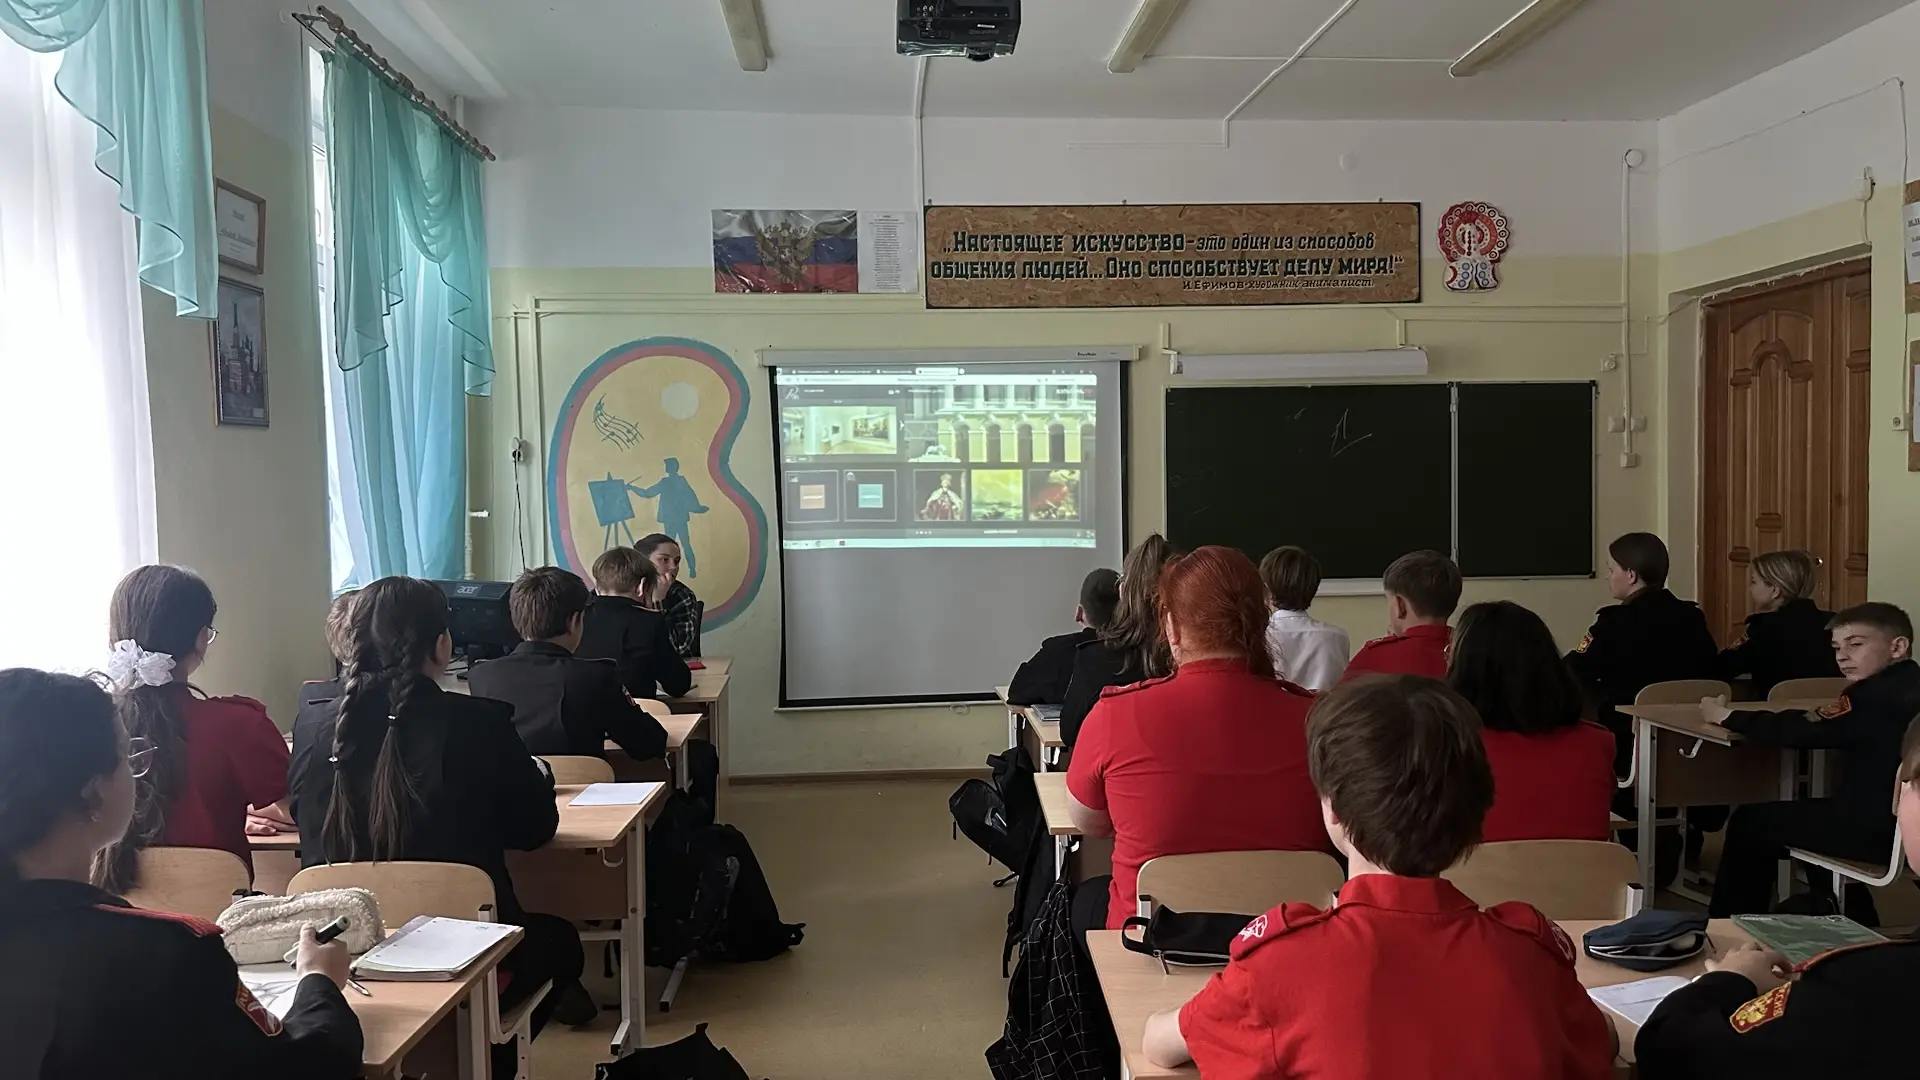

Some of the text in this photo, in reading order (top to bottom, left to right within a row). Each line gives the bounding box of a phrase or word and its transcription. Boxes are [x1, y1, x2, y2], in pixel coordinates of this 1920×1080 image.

[1232, 232, 1271, 251] один
[1274, 235, 1294, 250] из
[1298, 231, 1376, 250] способов
[931, 260, 1016, 280] ОБЩЕНИЯ
[1148, 259, 1280, 278] СПОСОБСТВУЕТ
[1283, 258, 1334, 278] ДЕЛУ
[456, 585, 478, 595] acer
